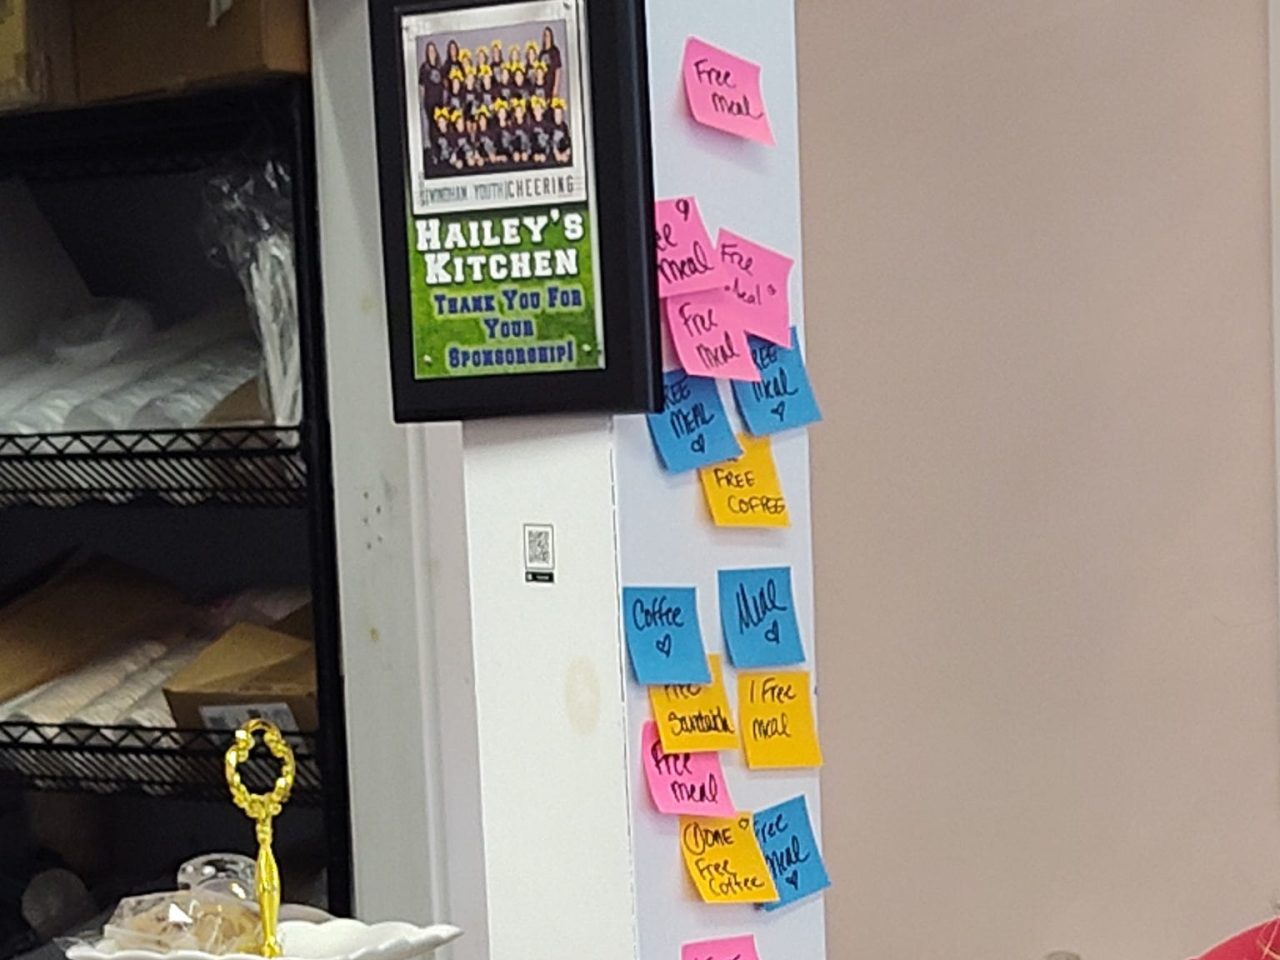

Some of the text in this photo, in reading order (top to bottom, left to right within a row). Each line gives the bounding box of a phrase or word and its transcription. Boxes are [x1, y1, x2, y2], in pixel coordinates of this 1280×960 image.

[693, 58, 737, 89] Free
[508, 175, 575, 199] CHEERING
[415, 208, 584, 251] HAILEY'S
[424, 248, 579, 285] KITCHEN
[720, 242, 754, 277] Free
[433, 286, 583, 315] THANK YOU FOR
[484, 317, 535, 339] YOUR
[678, 302, 719, 339] Free
[448, 340, 574, 368] SPONSORSHIP!
[752, 345, 778, 371] REE
[664, 381, 692, 407] REE
[713, 468, 755, 489] FREE
[632, 595, 685, 631] Coffee
[761, 677, 797, 703] Free
[694, 858, 736, 880] Free
[709, 873, 765, 897] Coffee
